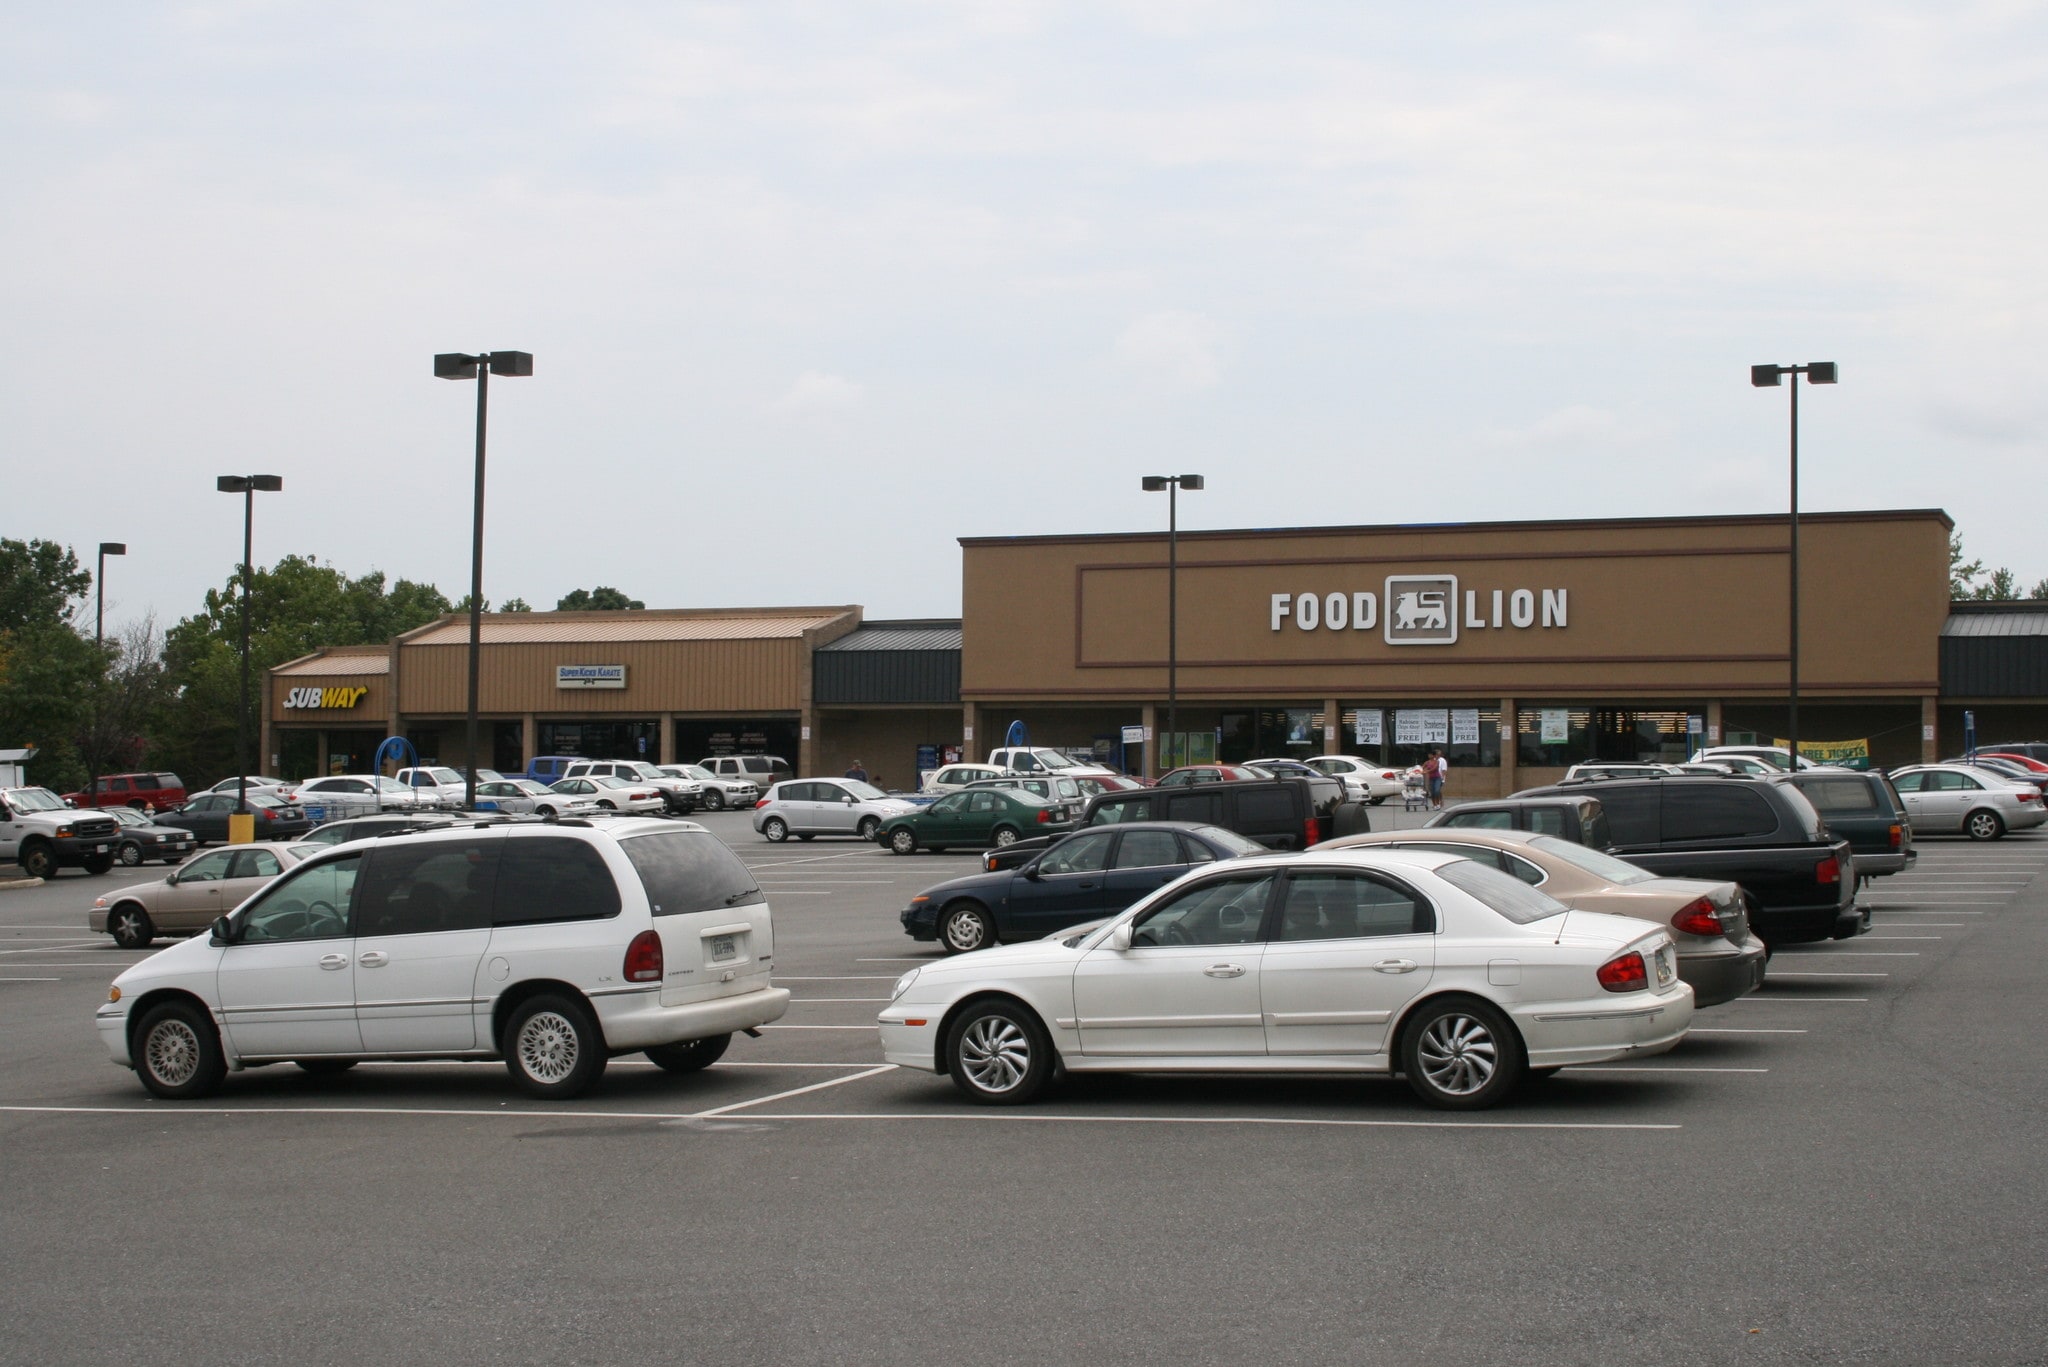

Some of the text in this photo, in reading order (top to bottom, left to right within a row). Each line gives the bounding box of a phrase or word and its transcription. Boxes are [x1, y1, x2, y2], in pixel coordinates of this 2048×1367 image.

[1271, 588, 1568, 631] FOOD LION
[597, 667, 621, 677] KARATE
[282, 685, 368, 709] SUBWAY
[1803, 746, 1865, 759] FREE TICKETS
